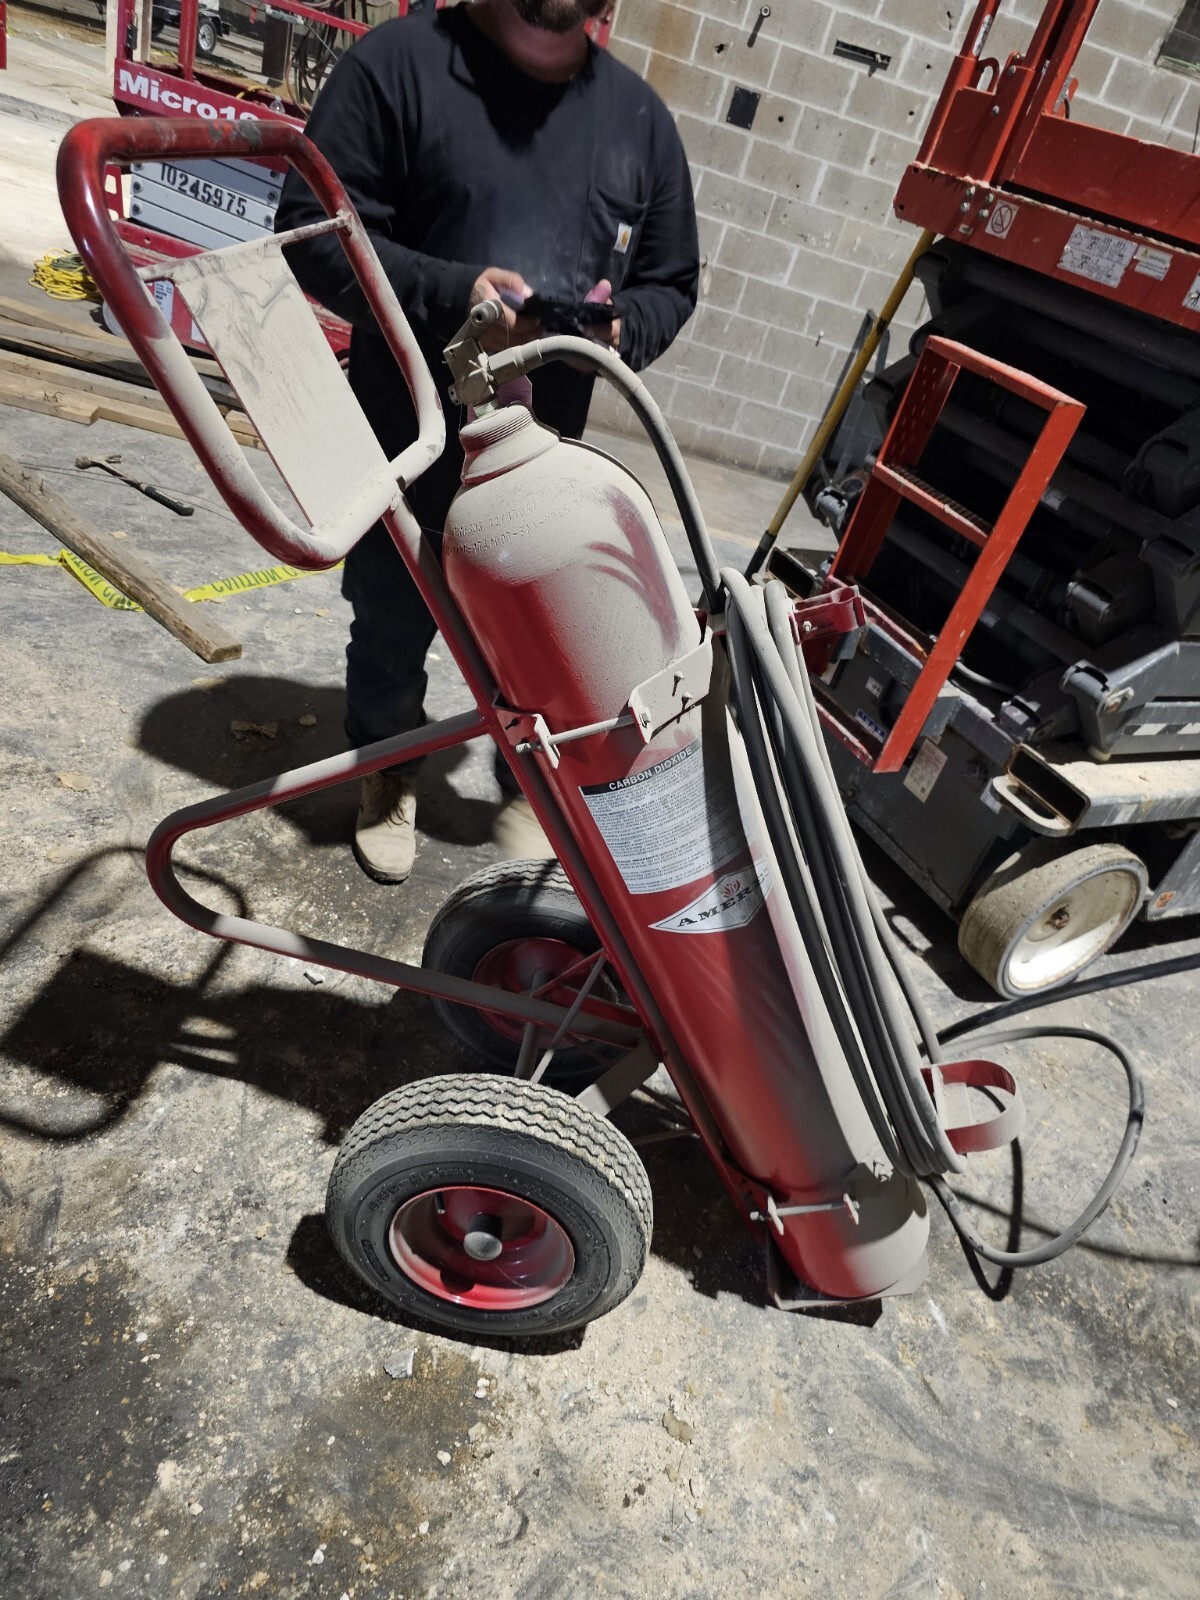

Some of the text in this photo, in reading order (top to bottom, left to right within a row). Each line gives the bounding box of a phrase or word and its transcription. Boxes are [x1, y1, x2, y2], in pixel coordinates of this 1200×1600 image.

[160, 164, 247, 216] 10245975
[608, 746, 694, 791] CARBON DIOXIDE
